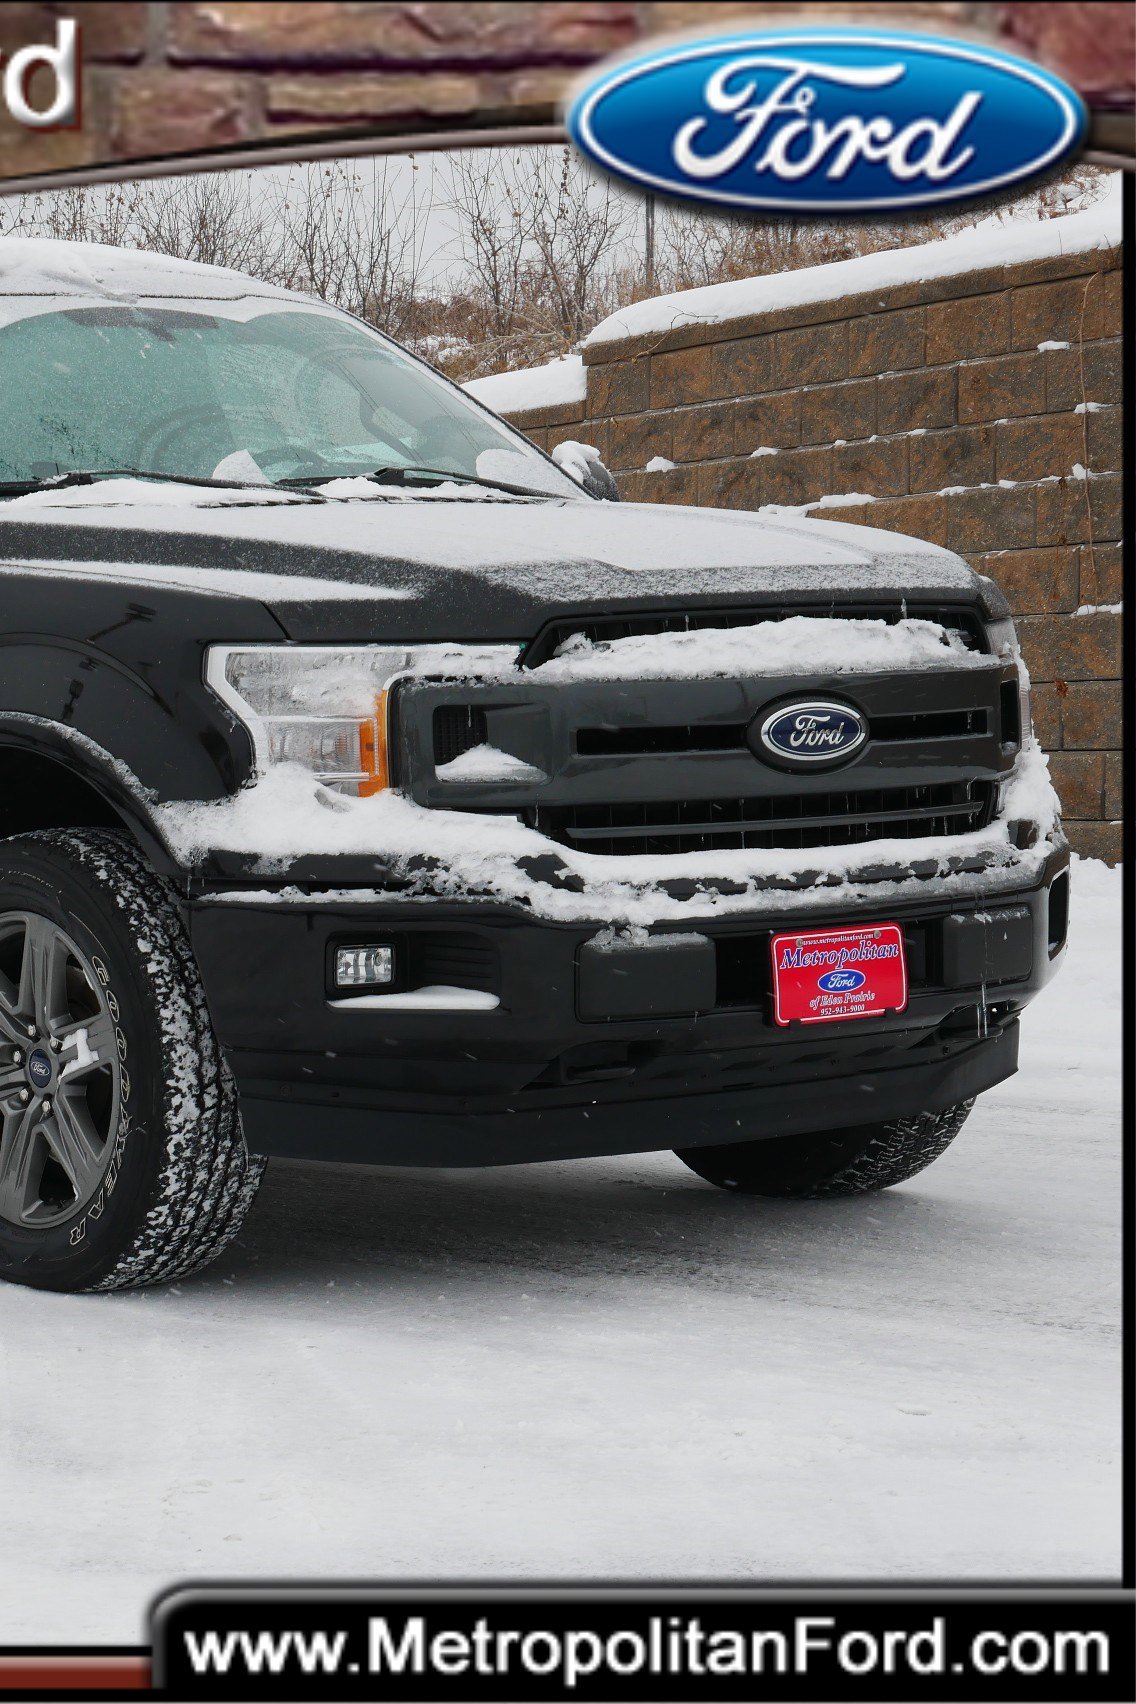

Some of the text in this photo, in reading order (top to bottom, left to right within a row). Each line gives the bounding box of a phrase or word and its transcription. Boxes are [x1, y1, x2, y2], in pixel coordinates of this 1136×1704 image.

[789, 714, 845, 748] Ford
[780, 940, 899, 969] Metropolitan
[827, 972, 857, 989] Ford
[809, 991, 875, 1010] of Eden Prairie
[69, 955, 132, 1246] GOODYEAR
